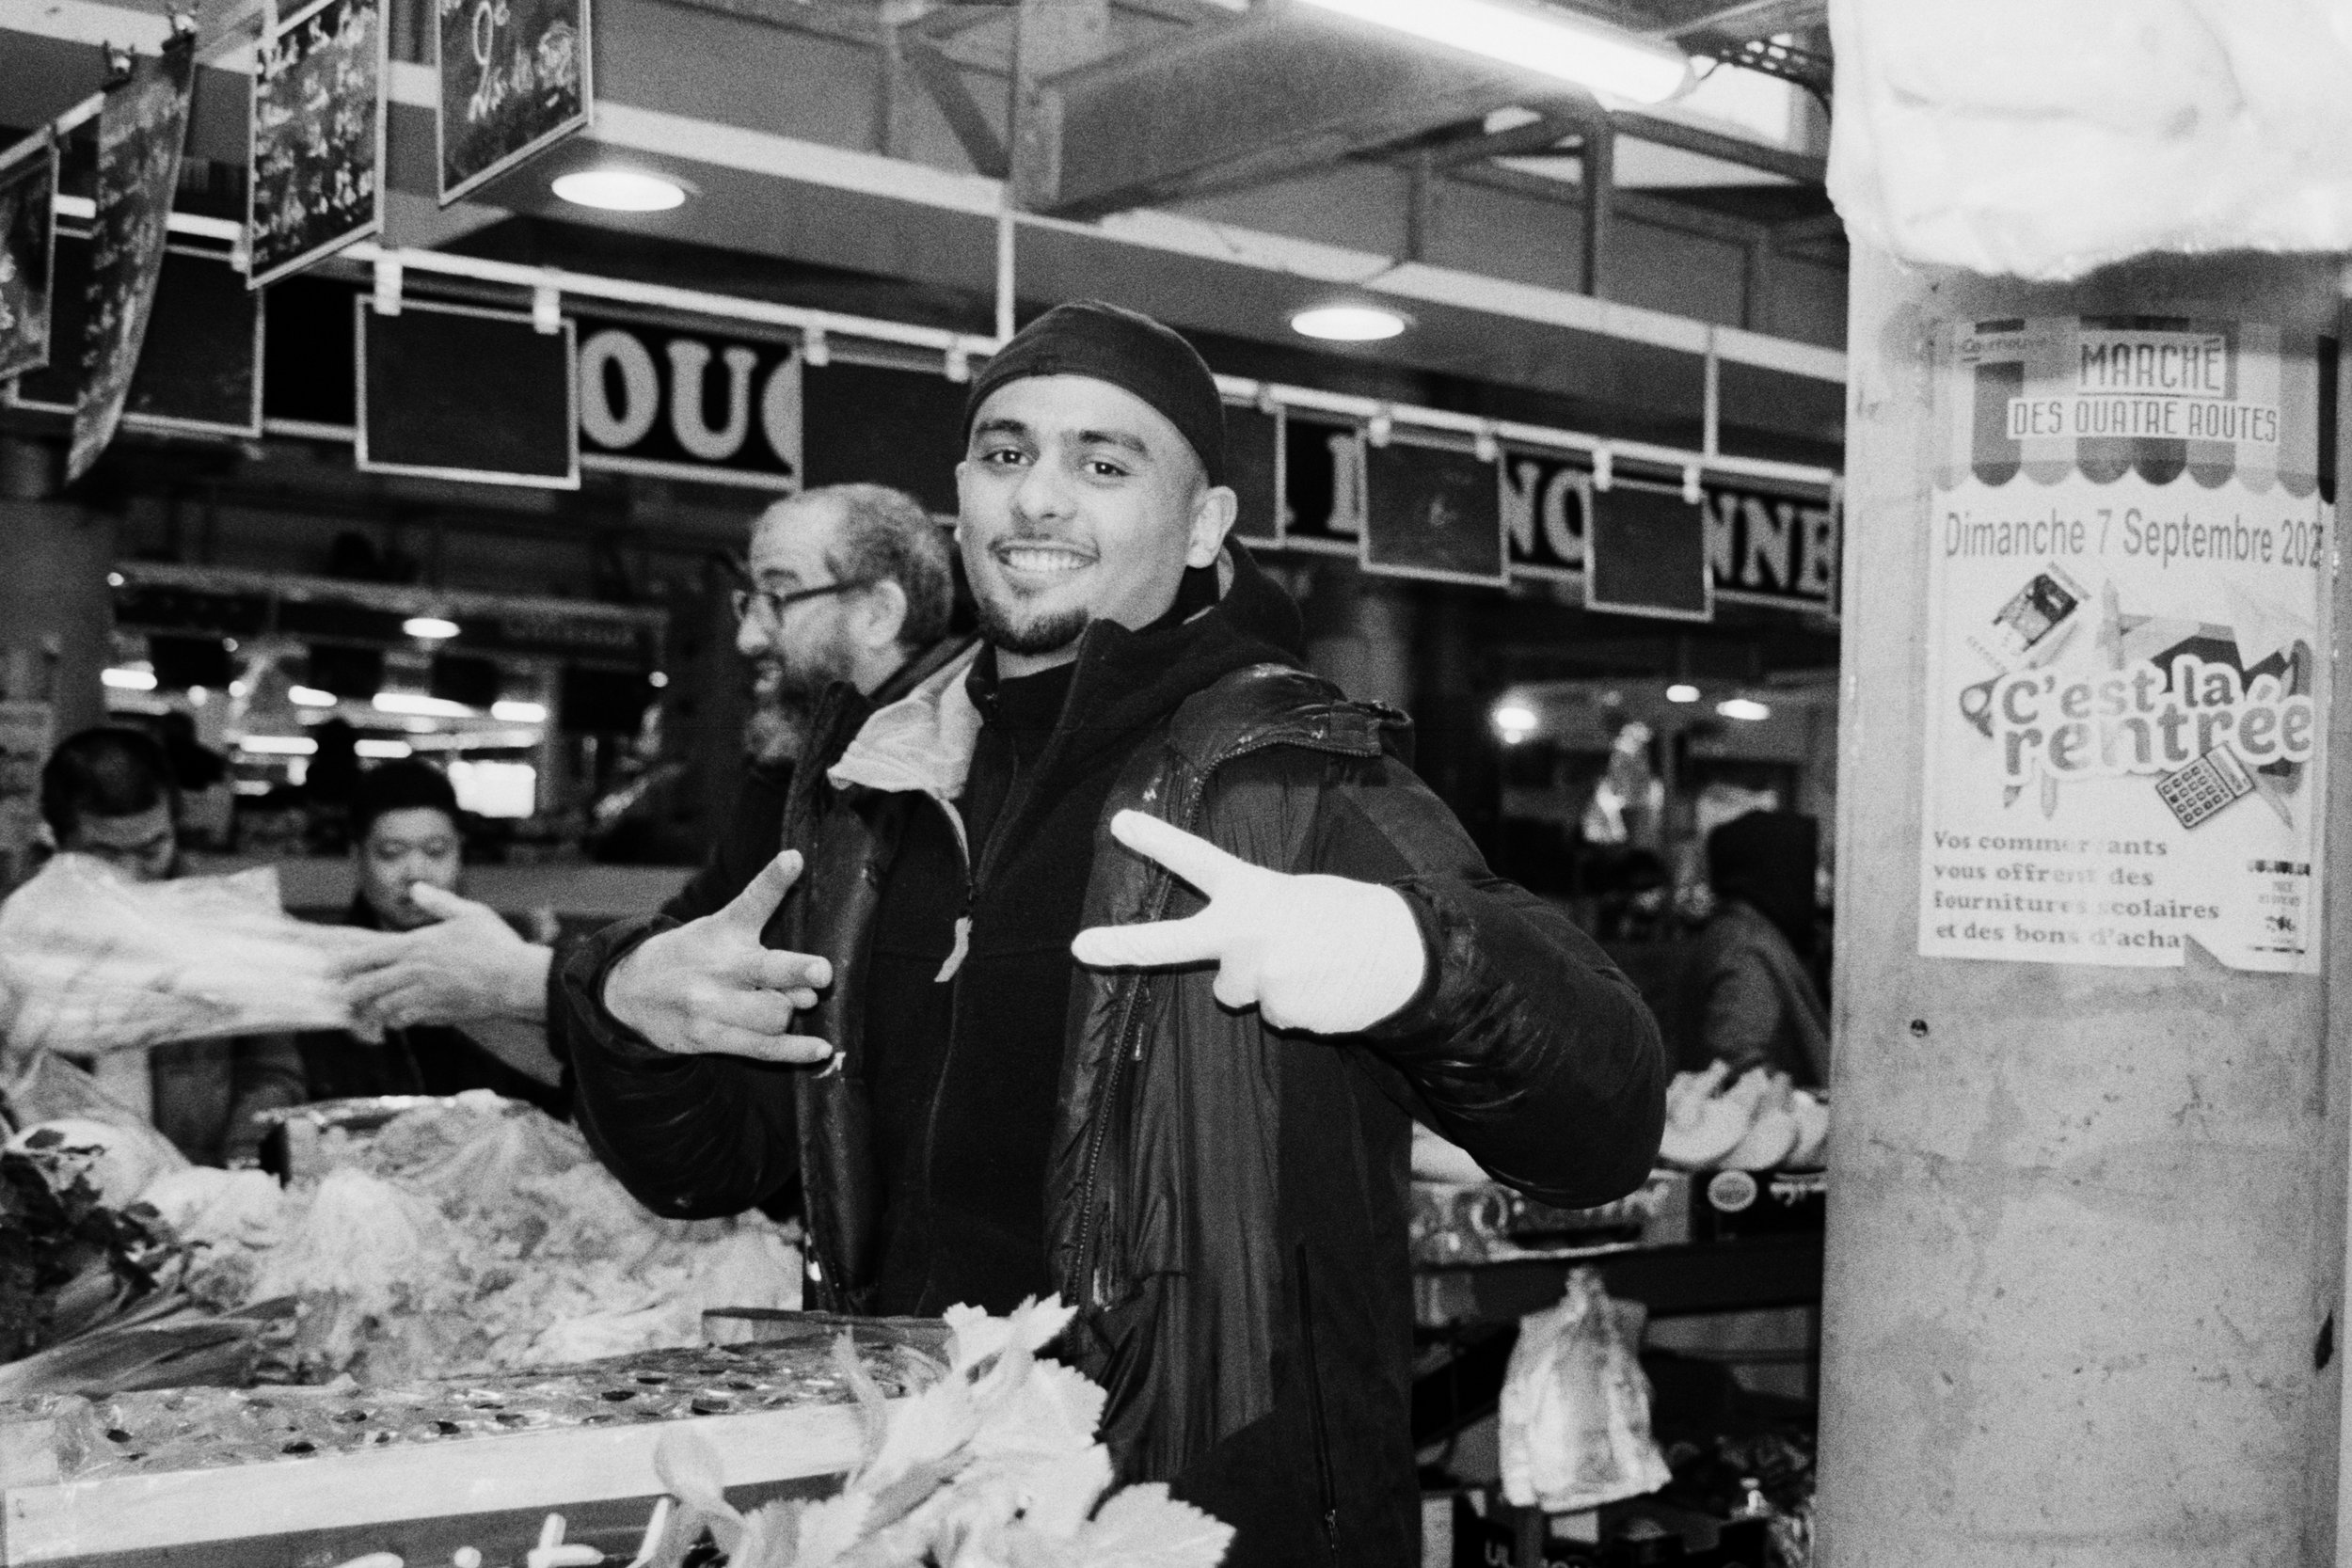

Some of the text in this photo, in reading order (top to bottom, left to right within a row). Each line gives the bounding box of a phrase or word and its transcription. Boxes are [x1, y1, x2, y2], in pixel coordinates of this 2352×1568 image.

[2080, 339, 2223, 391] MARCHÉ
[2014, 401, 2063, 436] DES
[2189, 403, 2278, 442] ROUTES
[1946, 509, 2085, 558] Dimanche
[2096, 509, 2113, 555] 7
[2123, 508, 2272, 569] Septembre
[2002, 665, 2233, 725] c'est la
[2005, 683, 2312, 776] rentrée
[1934, 831, 1970, 849] Vos
[1934, 863, 2153, 885] vous offrent des
[1936, 923, 1956, 939] et
[1964, 922, 2004, 941] des
[2089, 927, 2187, 948] d'acha
